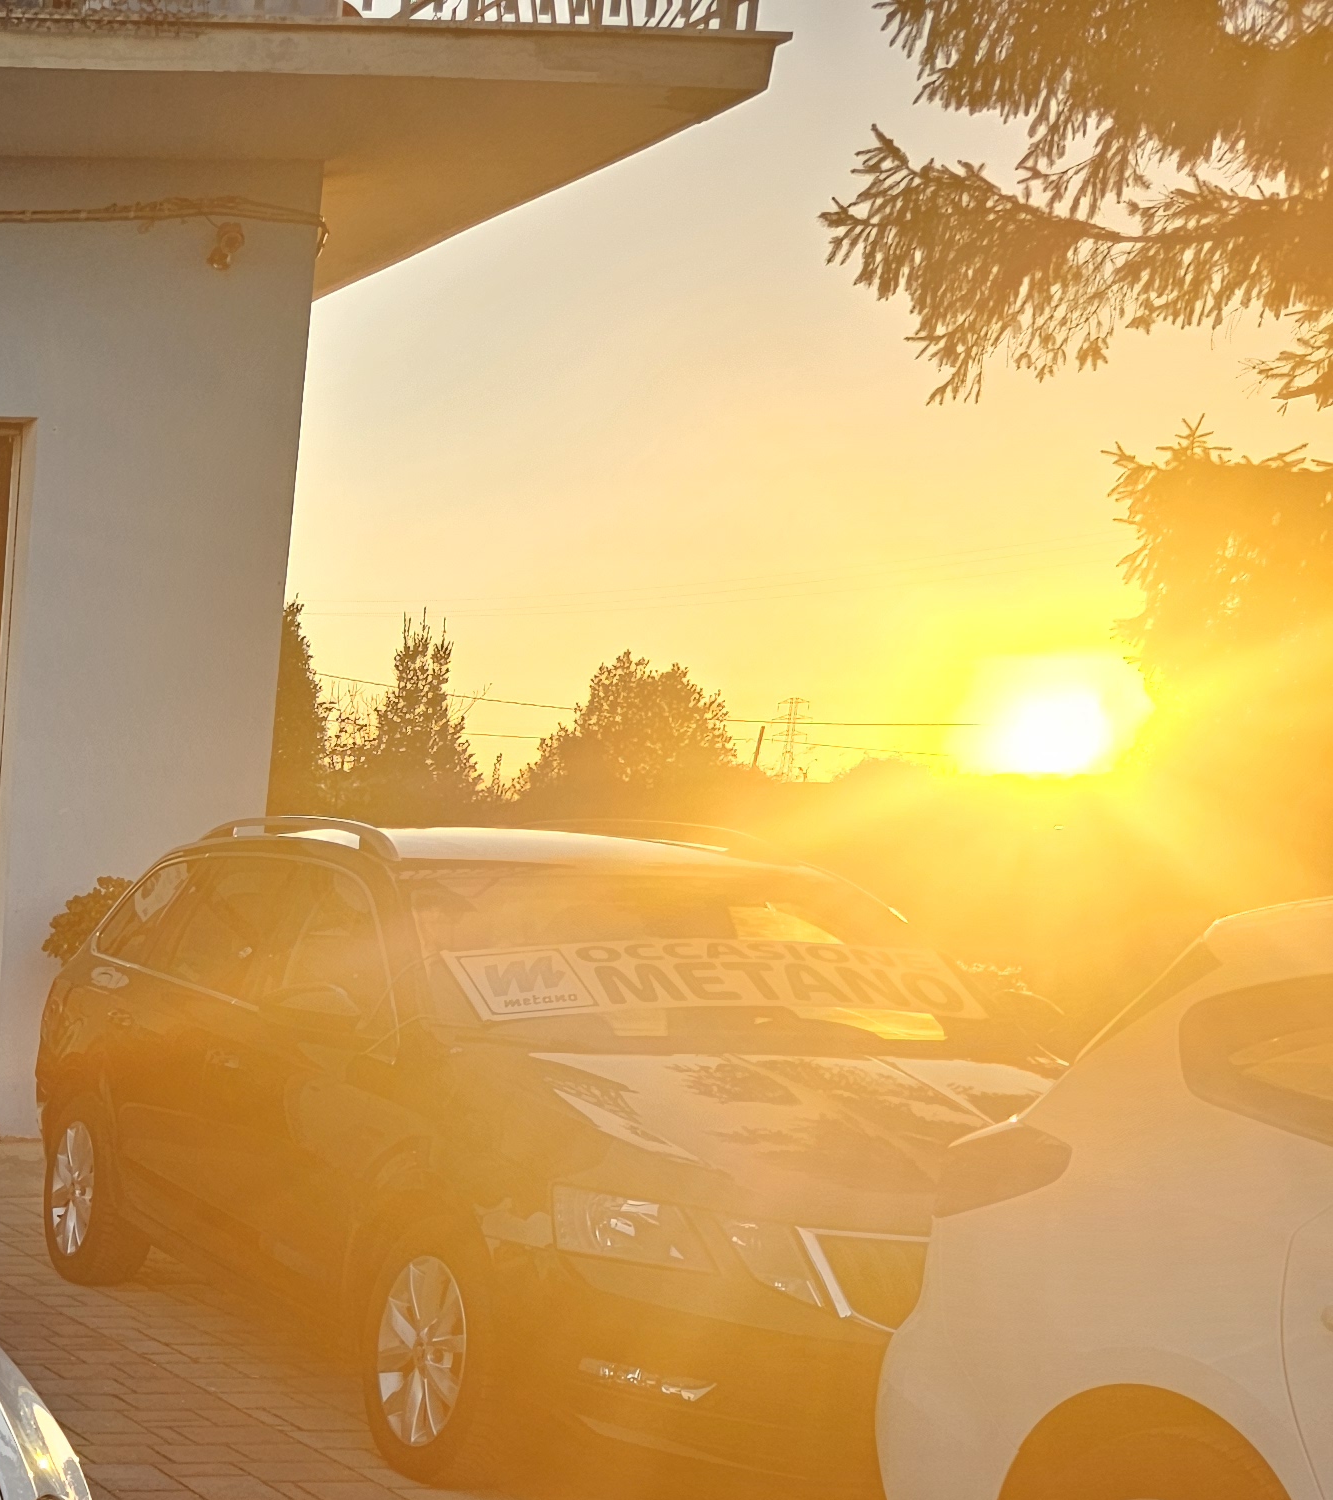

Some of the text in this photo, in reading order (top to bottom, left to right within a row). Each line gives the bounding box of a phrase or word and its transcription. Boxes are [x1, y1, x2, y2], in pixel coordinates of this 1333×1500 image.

[574, 942, 937, 973] OCCASIONE
[503, 993, 578, 1008] metano
[593, 962, 965, 1012] METANO
